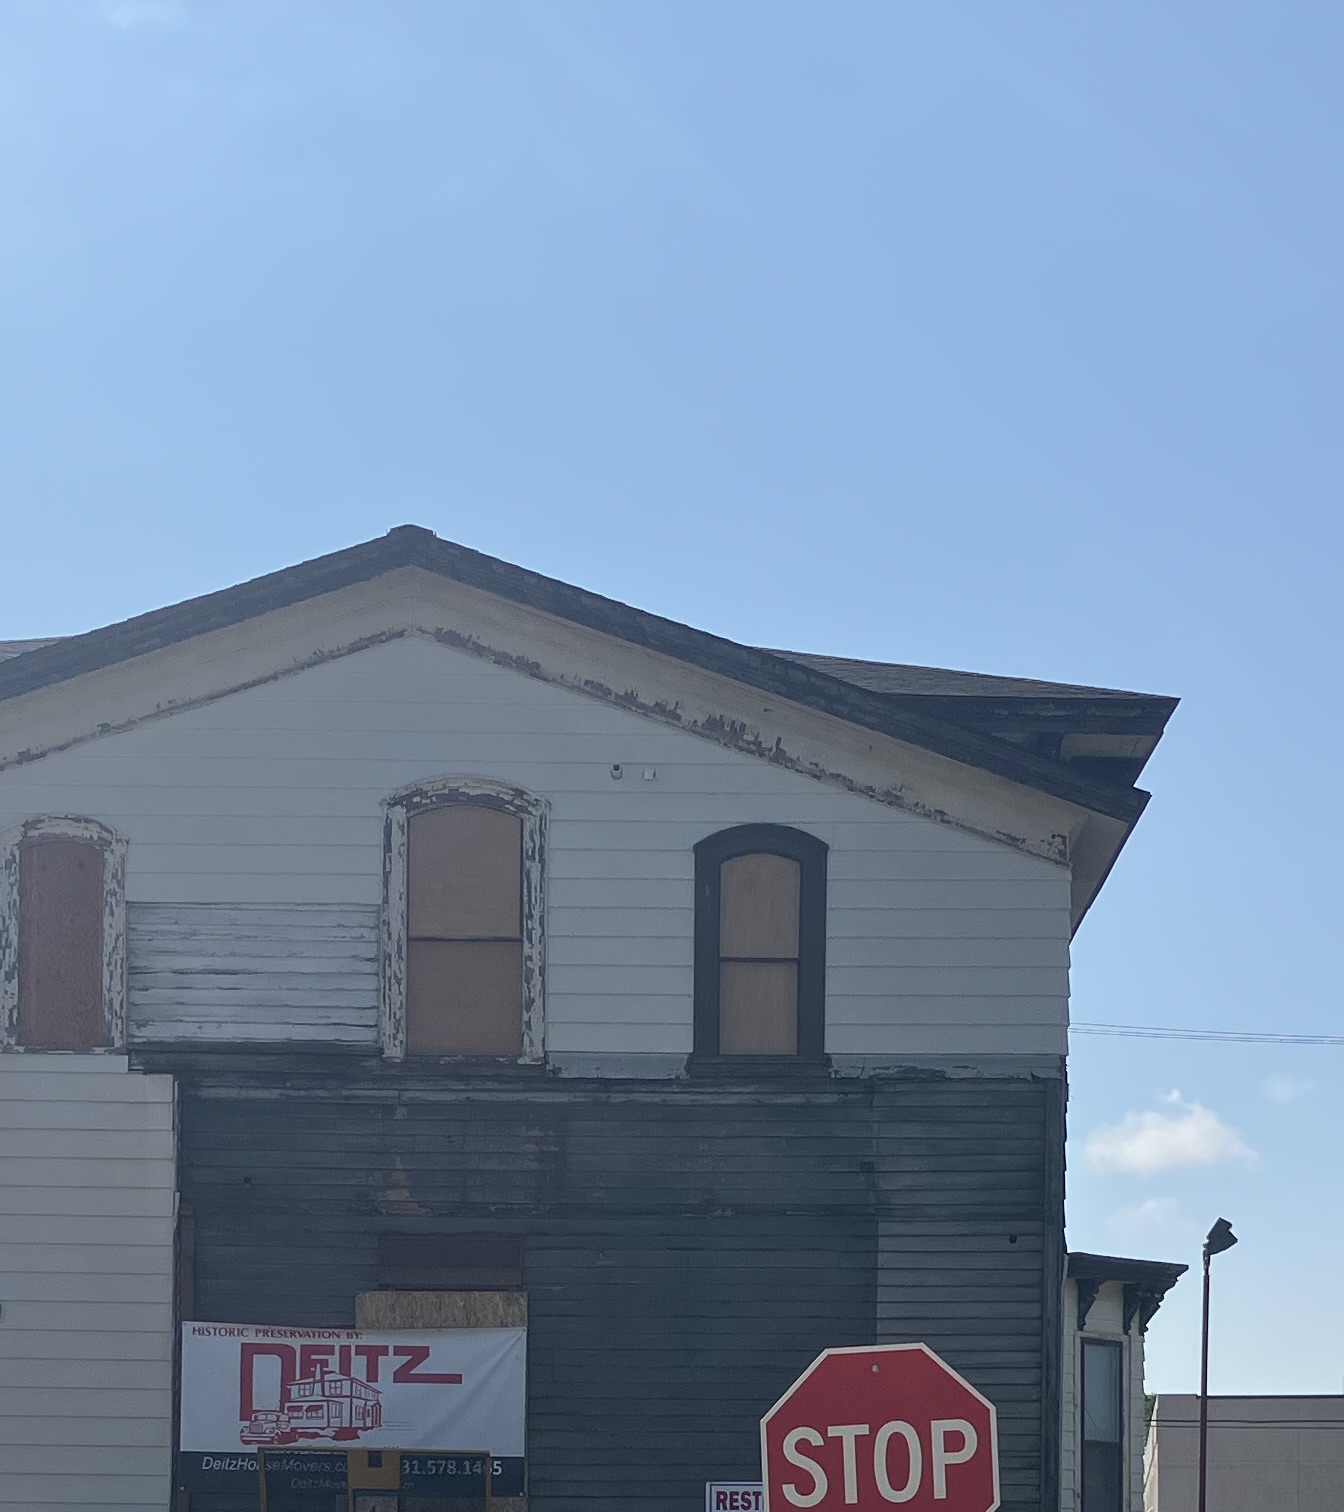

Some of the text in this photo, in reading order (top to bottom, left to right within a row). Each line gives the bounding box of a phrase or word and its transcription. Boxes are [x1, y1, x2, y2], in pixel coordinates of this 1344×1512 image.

[192, 1326, 364, 1340] HISTORIC PRESERVATION BY:
[239, 1342, 463, 1421] DEITZ
[781, 1418, 978, 1508] STOP
[715, 1490, 762, 1511] REST
